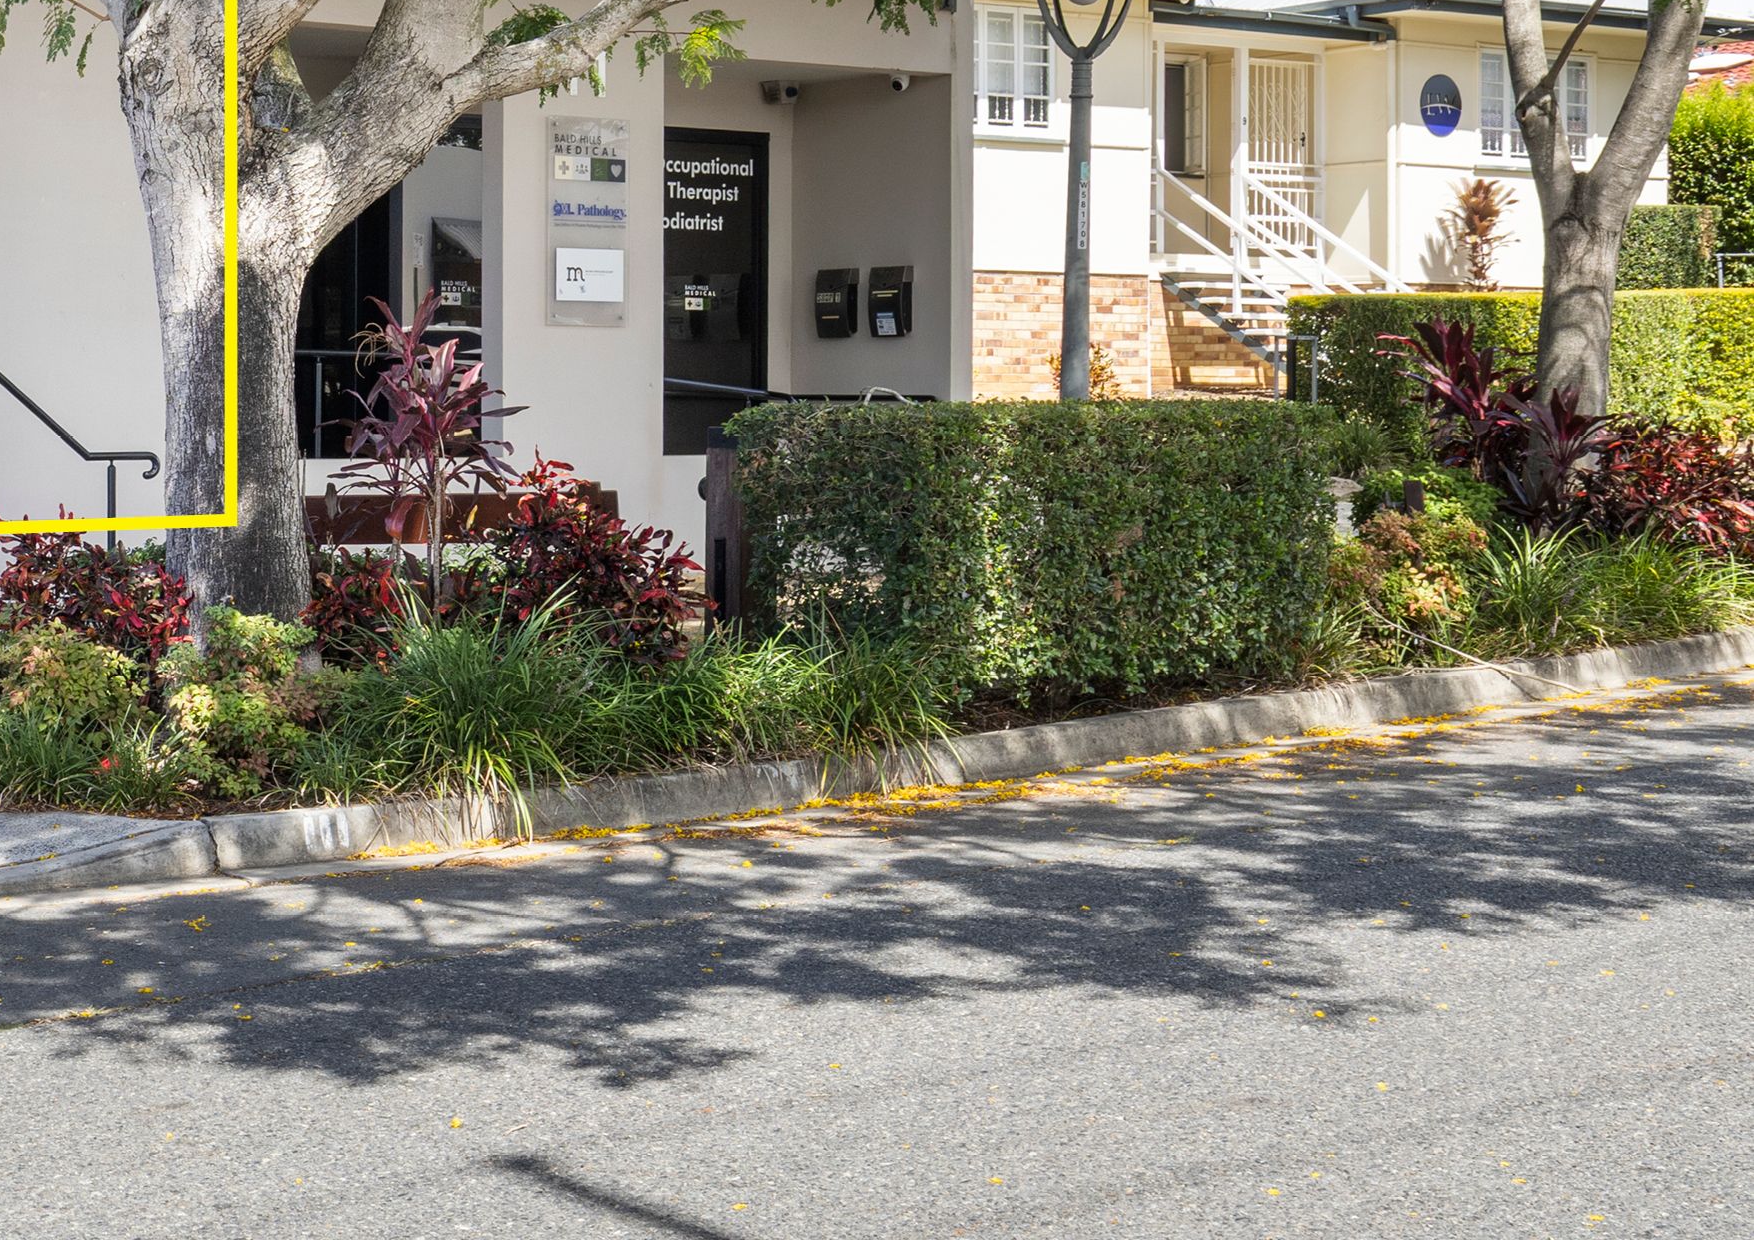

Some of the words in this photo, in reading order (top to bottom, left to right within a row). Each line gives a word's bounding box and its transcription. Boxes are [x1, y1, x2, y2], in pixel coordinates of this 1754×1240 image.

[554, 133, 576, 144] BALD
[579, 135, 602, 146] HILLS
[554, 144, 617, 157] MEDICAL
[663, 157, 754, 178] ccupational
[667, 181, 739, 205] Therapist
[663, 211, 724, 231] odiatrist
